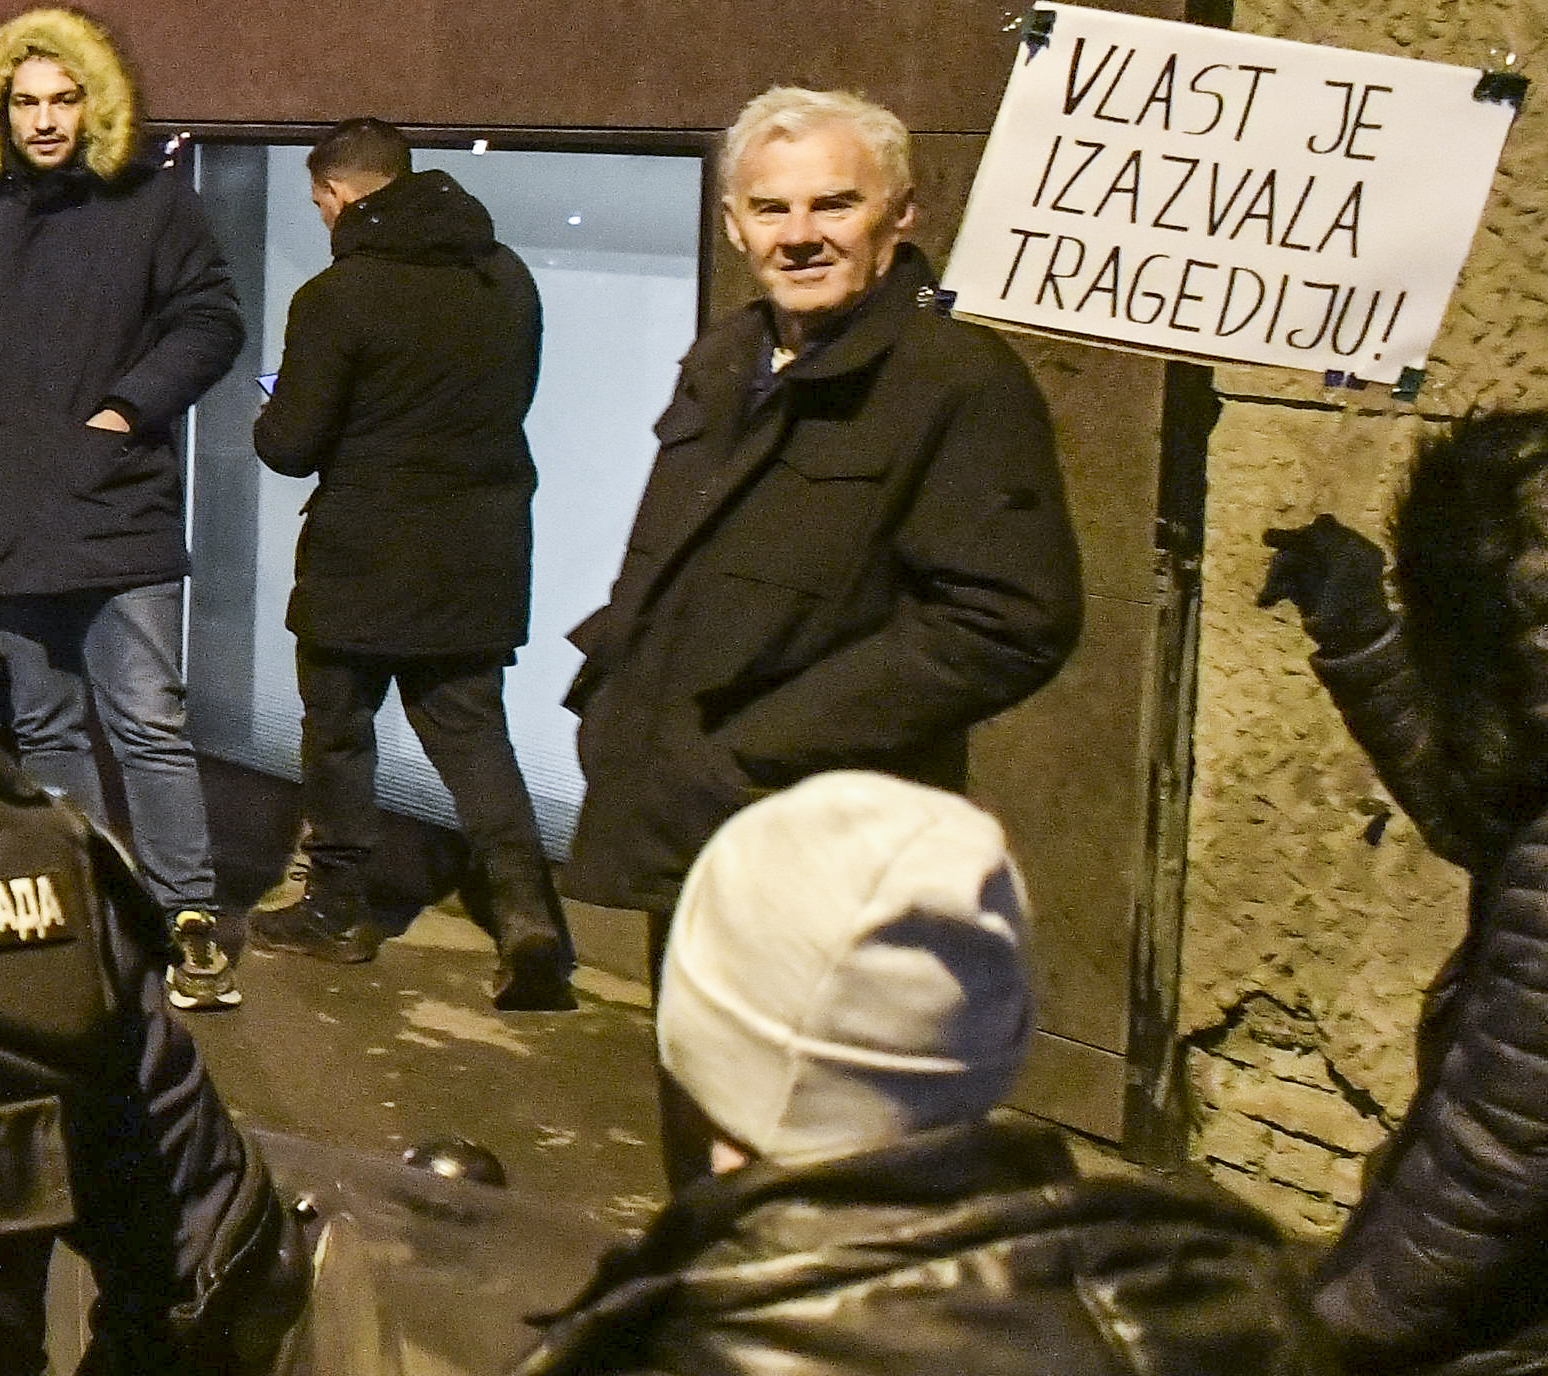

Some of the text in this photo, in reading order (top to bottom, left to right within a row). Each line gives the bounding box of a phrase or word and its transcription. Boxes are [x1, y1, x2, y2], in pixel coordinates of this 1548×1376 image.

[1063, 38, 1393, 162] VLAST JE
[1031, 135, 1364, 258] IZAZVALA
[998, 227, 1407, 361] TRAGEDIJU!
